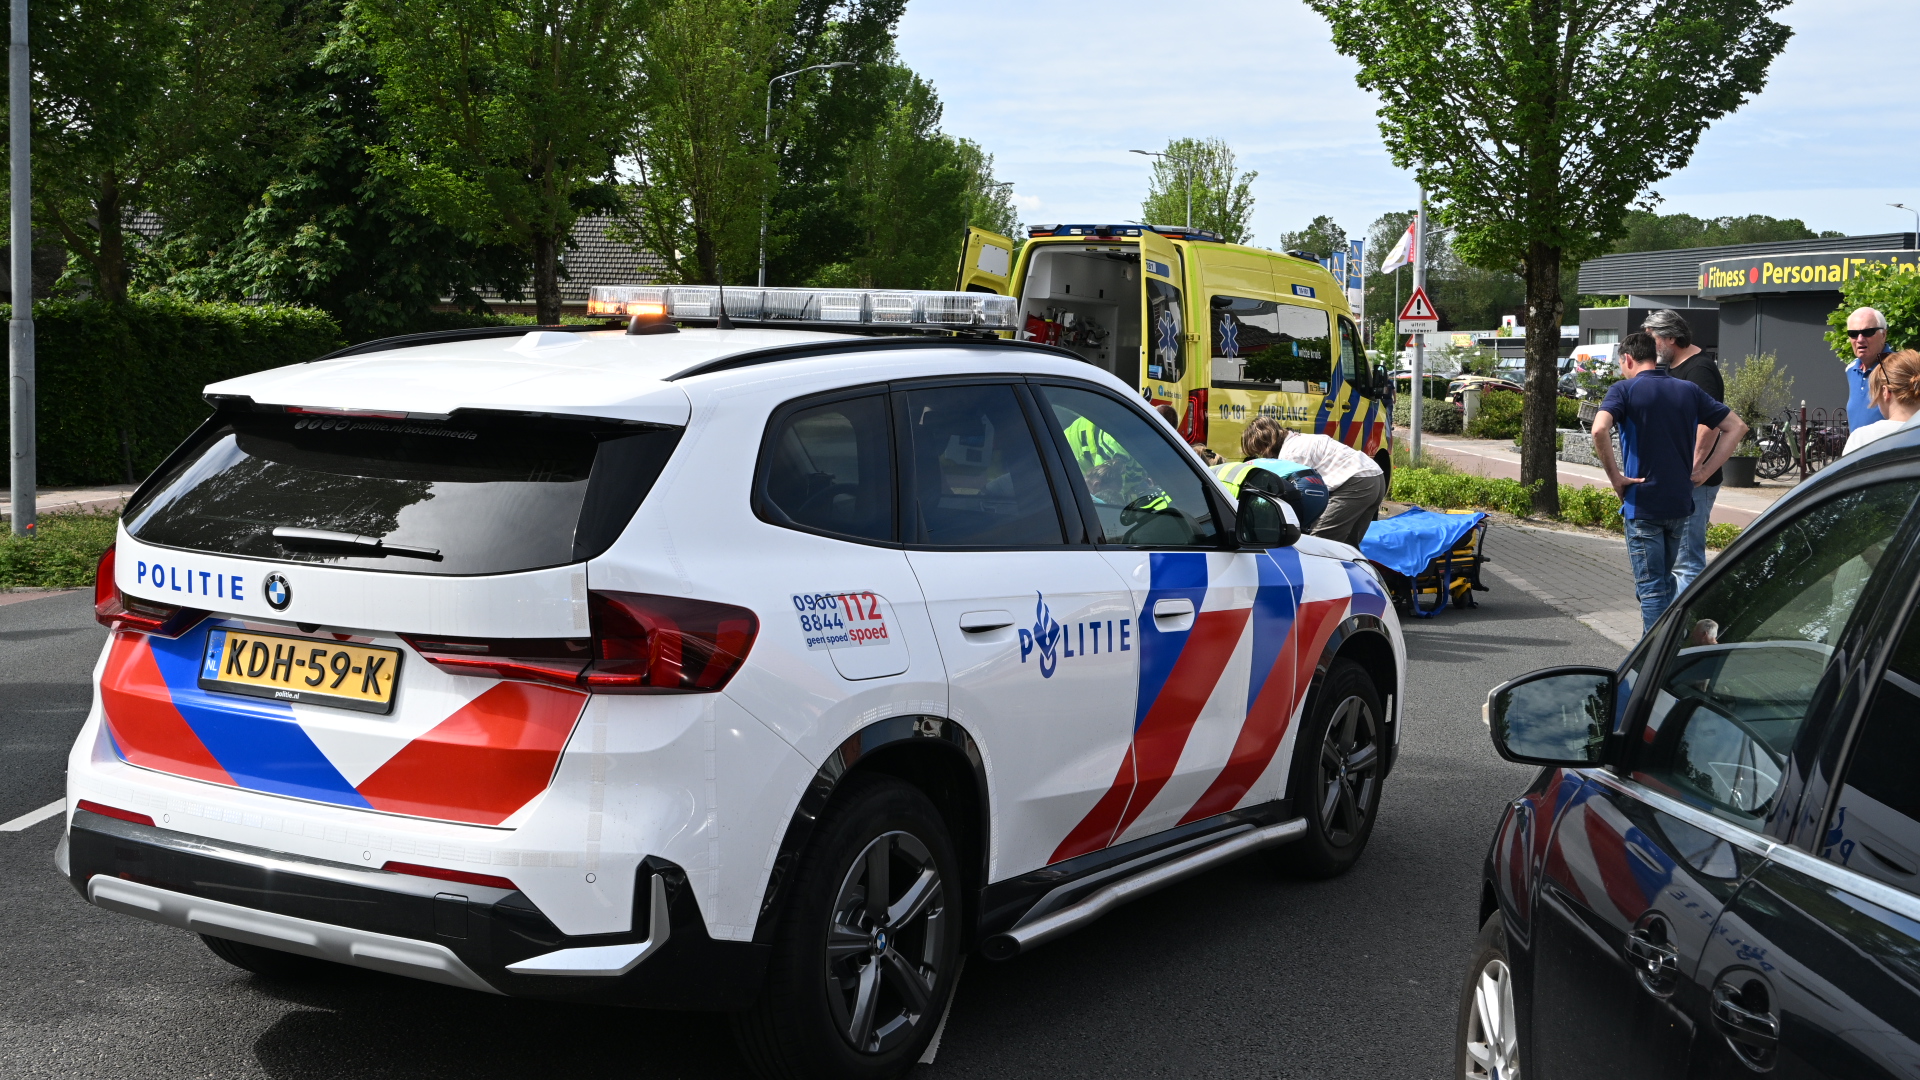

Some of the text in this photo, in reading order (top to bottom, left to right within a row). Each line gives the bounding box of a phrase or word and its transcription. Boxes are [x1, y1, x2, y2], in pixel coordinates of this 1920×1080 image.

[1709, 266, 1745, 288] Fitness
[1219, 404, 1245, 420] 10-181
[1258, 405, 1308, 421] AMBULANCE
[350, 421, 477, 440] politie.nl/socialmedia
[137, 561, 244, 601] POLITIE
[793, 593, 837, 612] 0900
[838, 591, 882, 621] 112
[800, 613, 844, 632] 8844
[807, 633, 848, 647] geen spoed
[849, 622, 888, 645] spoed
[206, 660, 217, 671] NL
[226, 638, 386, 695] KDH-59-K
[275, 691, 300, 699] politie.nl
